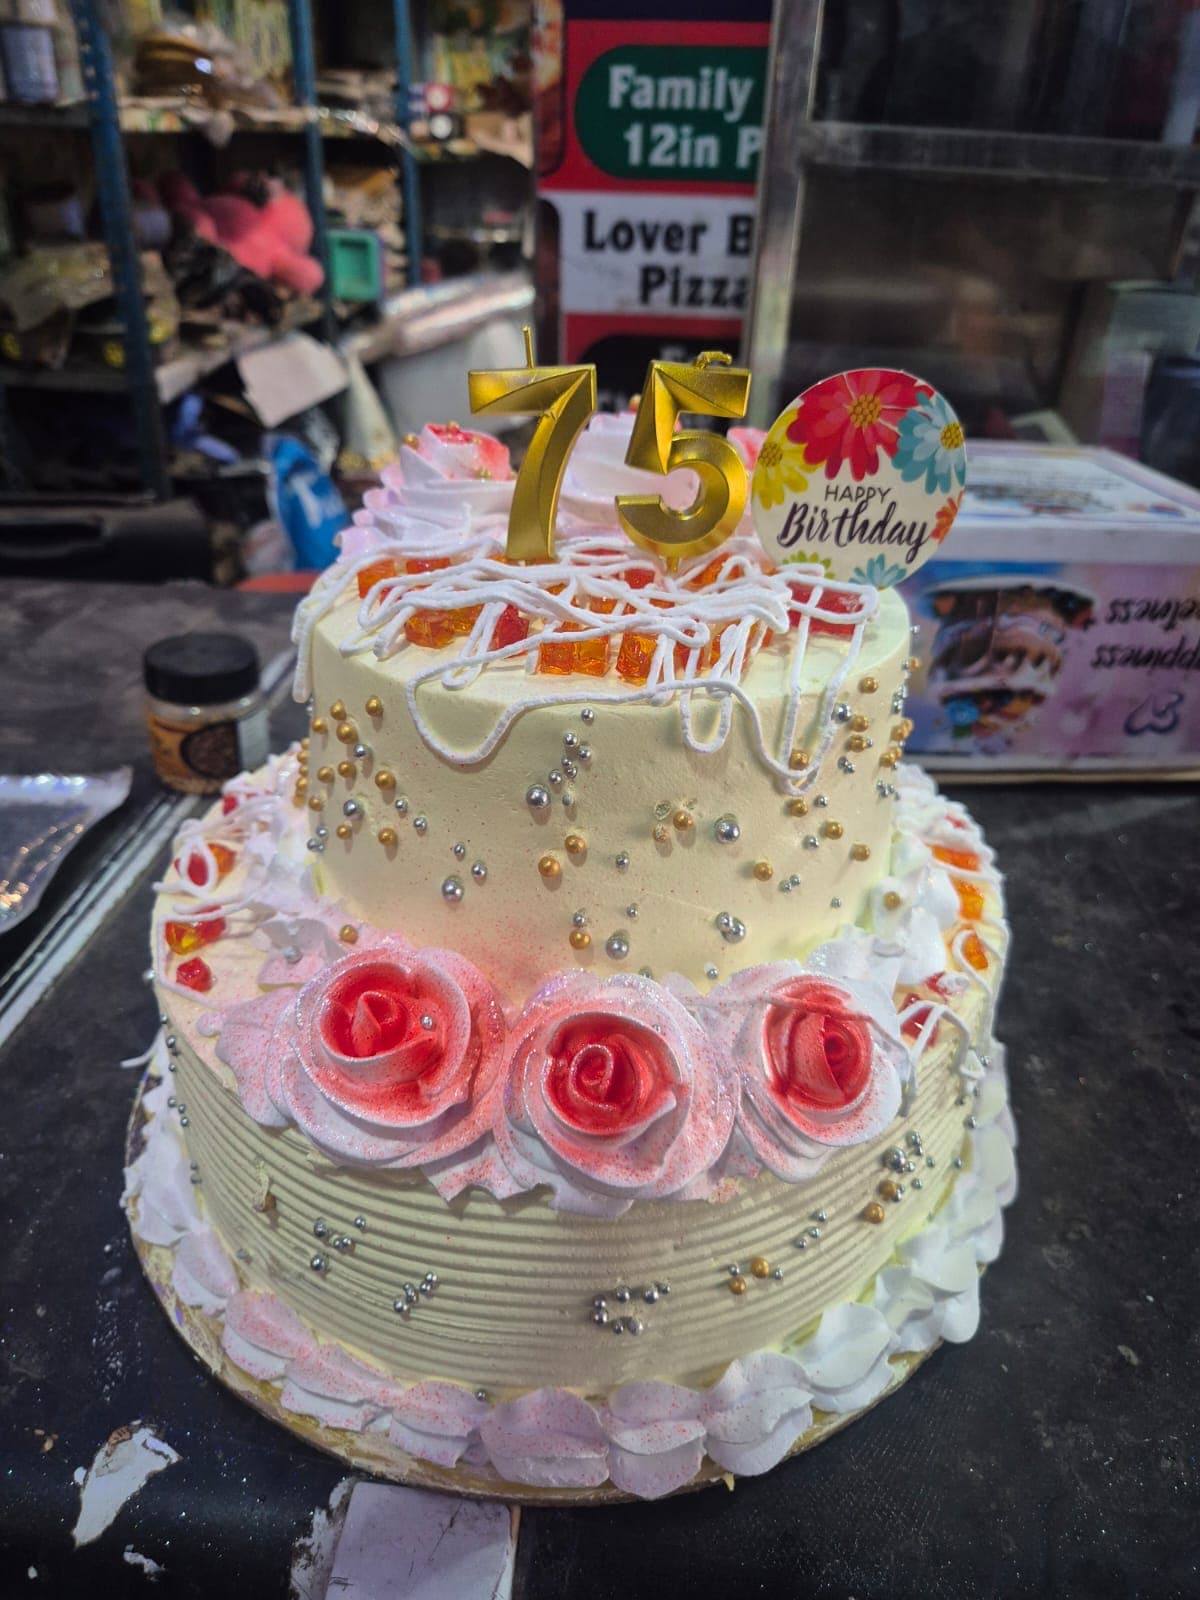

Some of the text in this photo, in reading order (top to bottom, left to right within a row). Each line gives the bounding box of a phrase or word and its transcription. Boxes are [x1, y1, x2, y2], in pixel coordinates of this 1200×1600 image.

[608, 64, 754, 122] Family
[624, 122, 719, 168] 12in
[583, 210, 708, 255] Lover
[823, 485, 892, 502] HAPPY
[776, 500, 931, 564] Birthday
